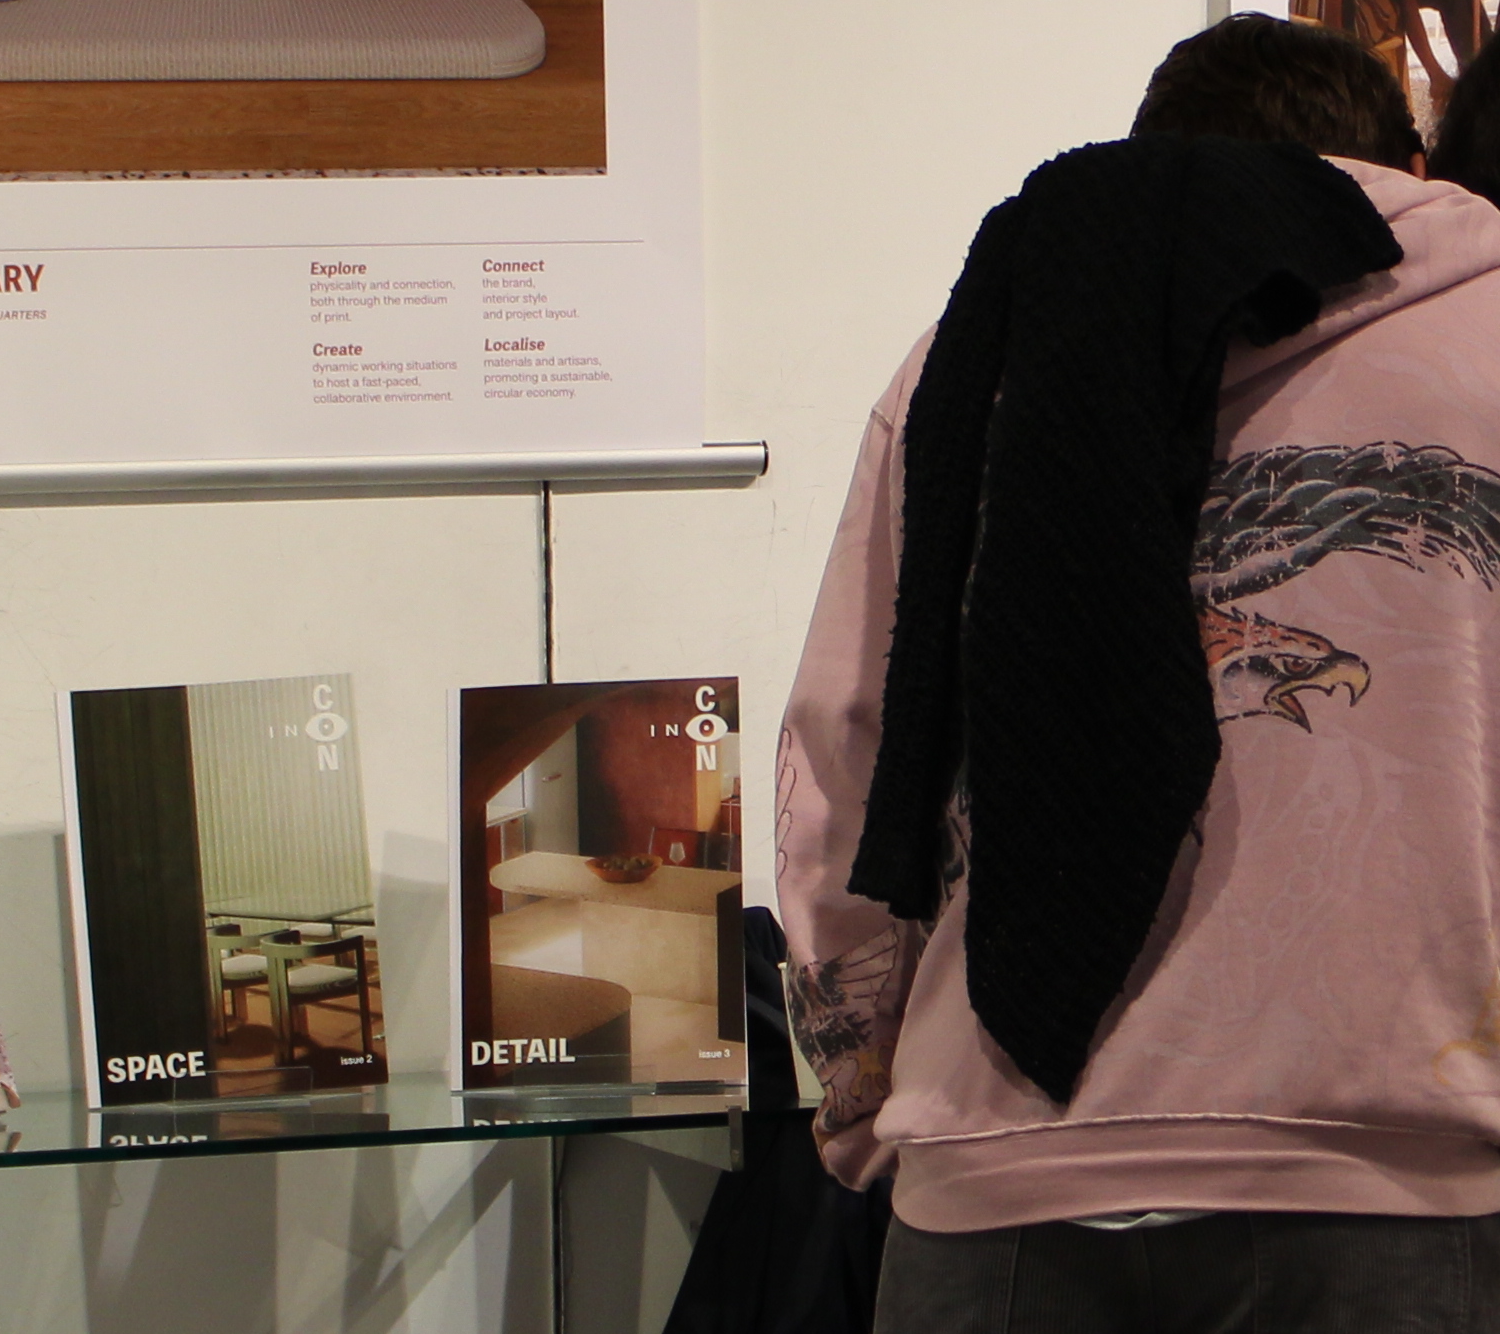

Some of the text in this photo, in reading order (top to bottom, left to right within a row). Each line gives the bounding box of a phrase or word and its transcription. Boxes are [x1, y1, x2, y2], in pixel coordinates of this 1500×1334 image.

[310, 261, 367, 278] Explore
[482, 259, 545, 273] Connect
[310, 278, 456, 293] physicality and connection,
[482, 278, 536, 289] the brand,
[310, 294, 448, 308] both through the medium
[482, 293, 548, 305] interior style
[310, 312, 322, 323] of
[483, 309, 503, 319] and
[505, 309, 543, 321] project
[312, 343, 363, 356] Create
[484, 337, 546, 352] Localise
[312, 360, 458, 374] dynamic working situations
[484, 357, 533, 368] materials
[535, 356, 555, 367] and
[313, 378, 324, 388] to
[326, 377, 350, 388] host
[352, 379, 360, 388] a
[484, 373, 539, 385] promoting
[541, 374, 548, 382] a
[313, 393, 382, 404] collaborative
[484, 389, 523, 399] circular
[471, 1037, 575, 1066] DETAIL
[699, 1049, 731, 1059] issue 3
[340, 1054, 373, 1066] issue 2
[107, 1051, 207, 1084] SPACE
